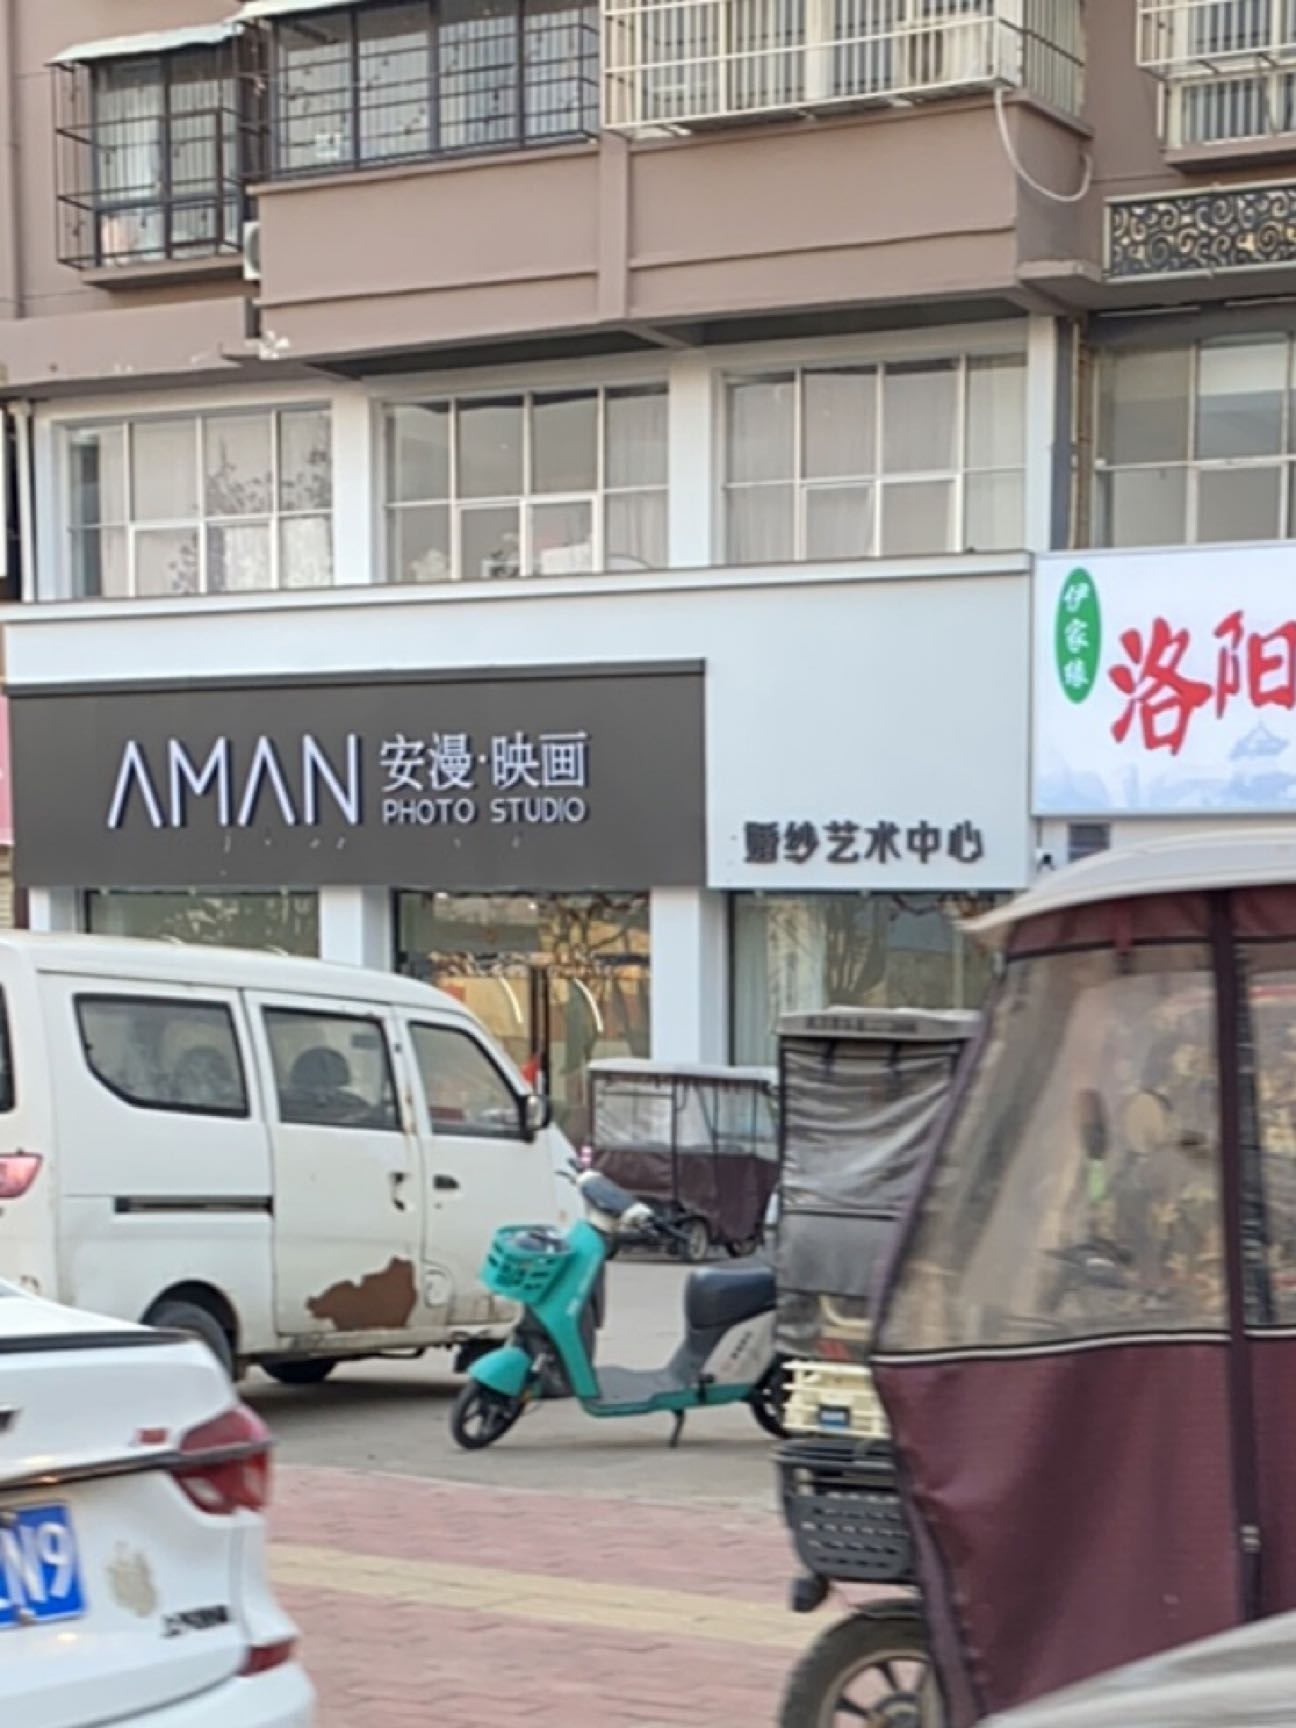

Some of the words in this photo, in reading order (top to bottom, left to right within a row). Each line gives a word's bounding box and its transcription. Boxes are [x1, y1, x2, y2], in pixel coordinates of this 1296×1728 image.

[106, 732, 361, 828] AMAN
[379, 731, 588, 792] 安漫·映画
[381, 798, 476, 825] PHOTO
[489, 796, 587, 823] STUDIO
[0, 1521, 74, 1608] N9
